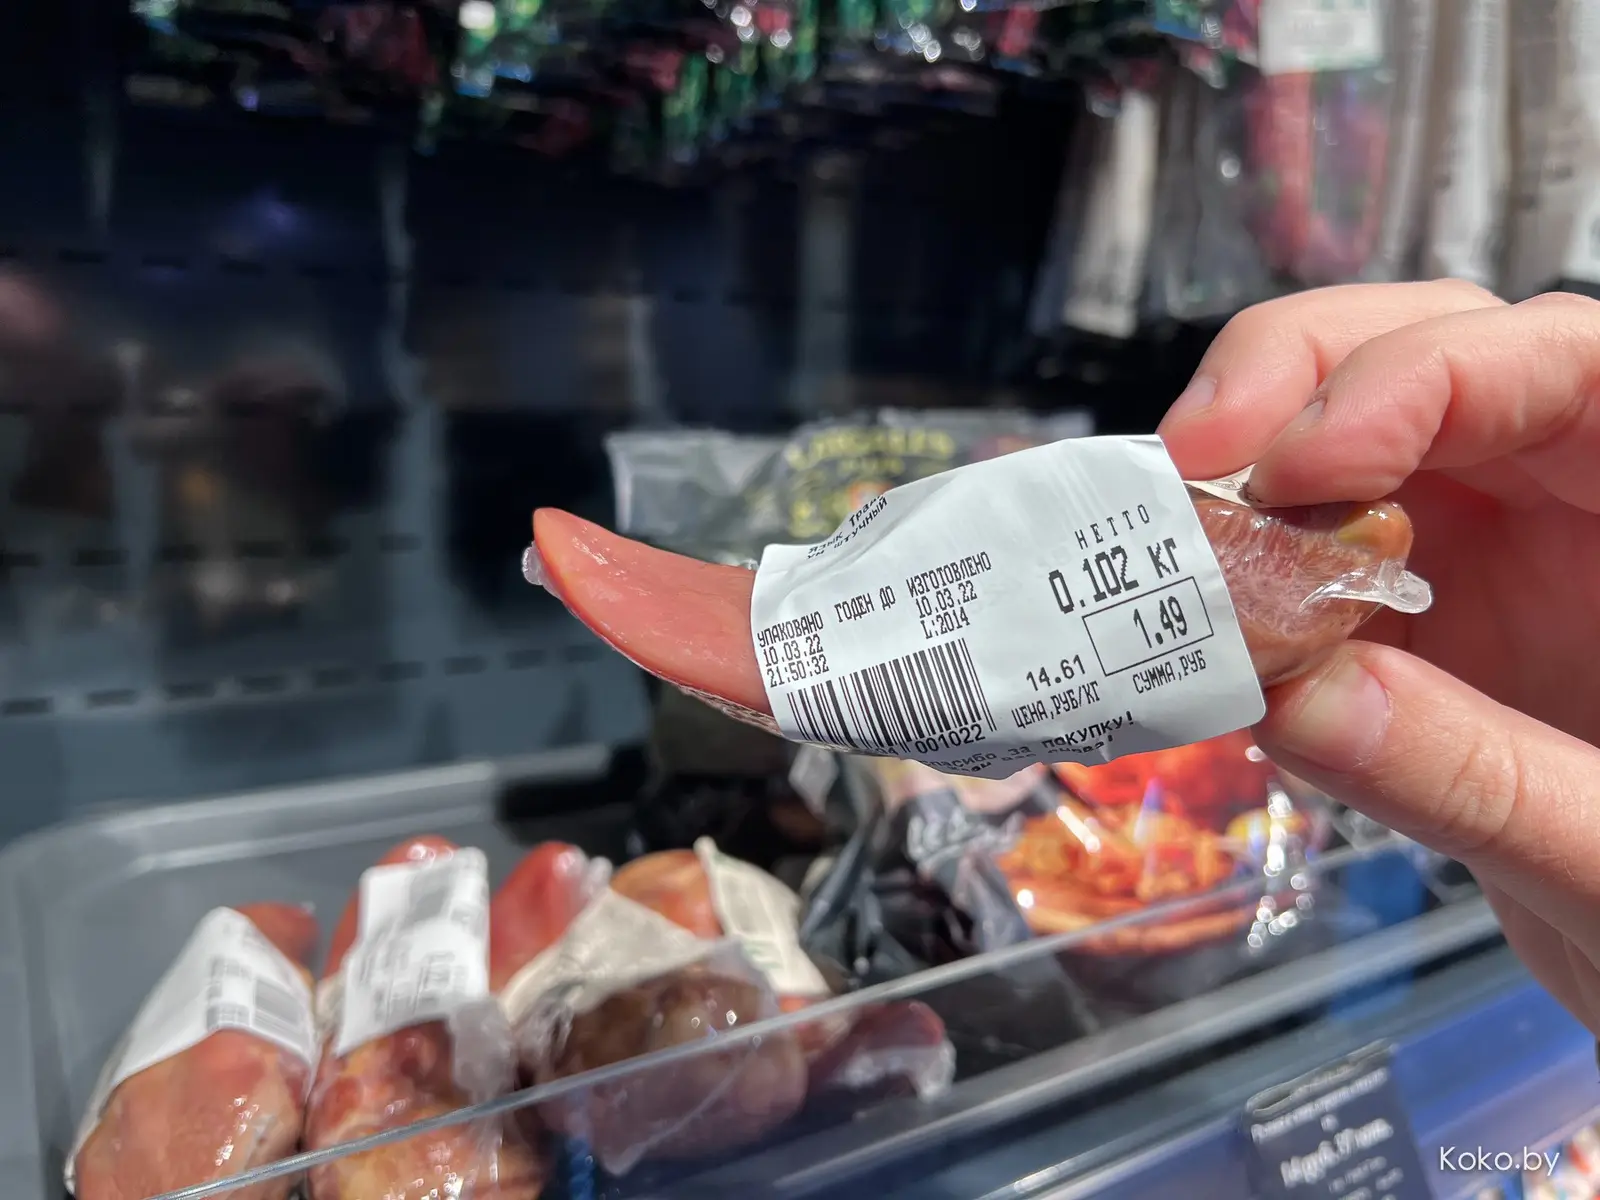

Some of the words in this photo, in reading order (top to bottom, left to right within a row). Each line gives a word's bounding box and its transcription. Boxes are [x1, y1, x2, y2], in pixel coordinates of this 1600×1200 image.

[833, 496, 887, 549] штучный
[1074, 504, 1150, 550] НЕТТО
[808, 531, 843, 554] Язык
[906, 551, 992, 598] ИЗГОТОВЛЕНО
[1048, 545, 1139, 615] 0.102
[834, 592, 875, 623] ГОДЕН
[879, 585, 896, 611] ДО
[915, 580, 978, 619] 10.03.22
[757, 610, 824, 648] УПАКОВАНО
[920, 606, 971, 640] L:2014
[1133, 596, 1188, 649] 1.49
[763, 633, 824, 667] 10.03.22
[766, 653, 830, 688] 21:50:32
[1026, 654, 1086, 691] 14.61
[1132, 650, 1207, 694] СУММА,РУБ
[1011, 680, 1101, 729] ЦЕНА,РУБ/КГ
[915, 724, 986, 754] 001022
[1041, 710, 1134, 748] покупку!
